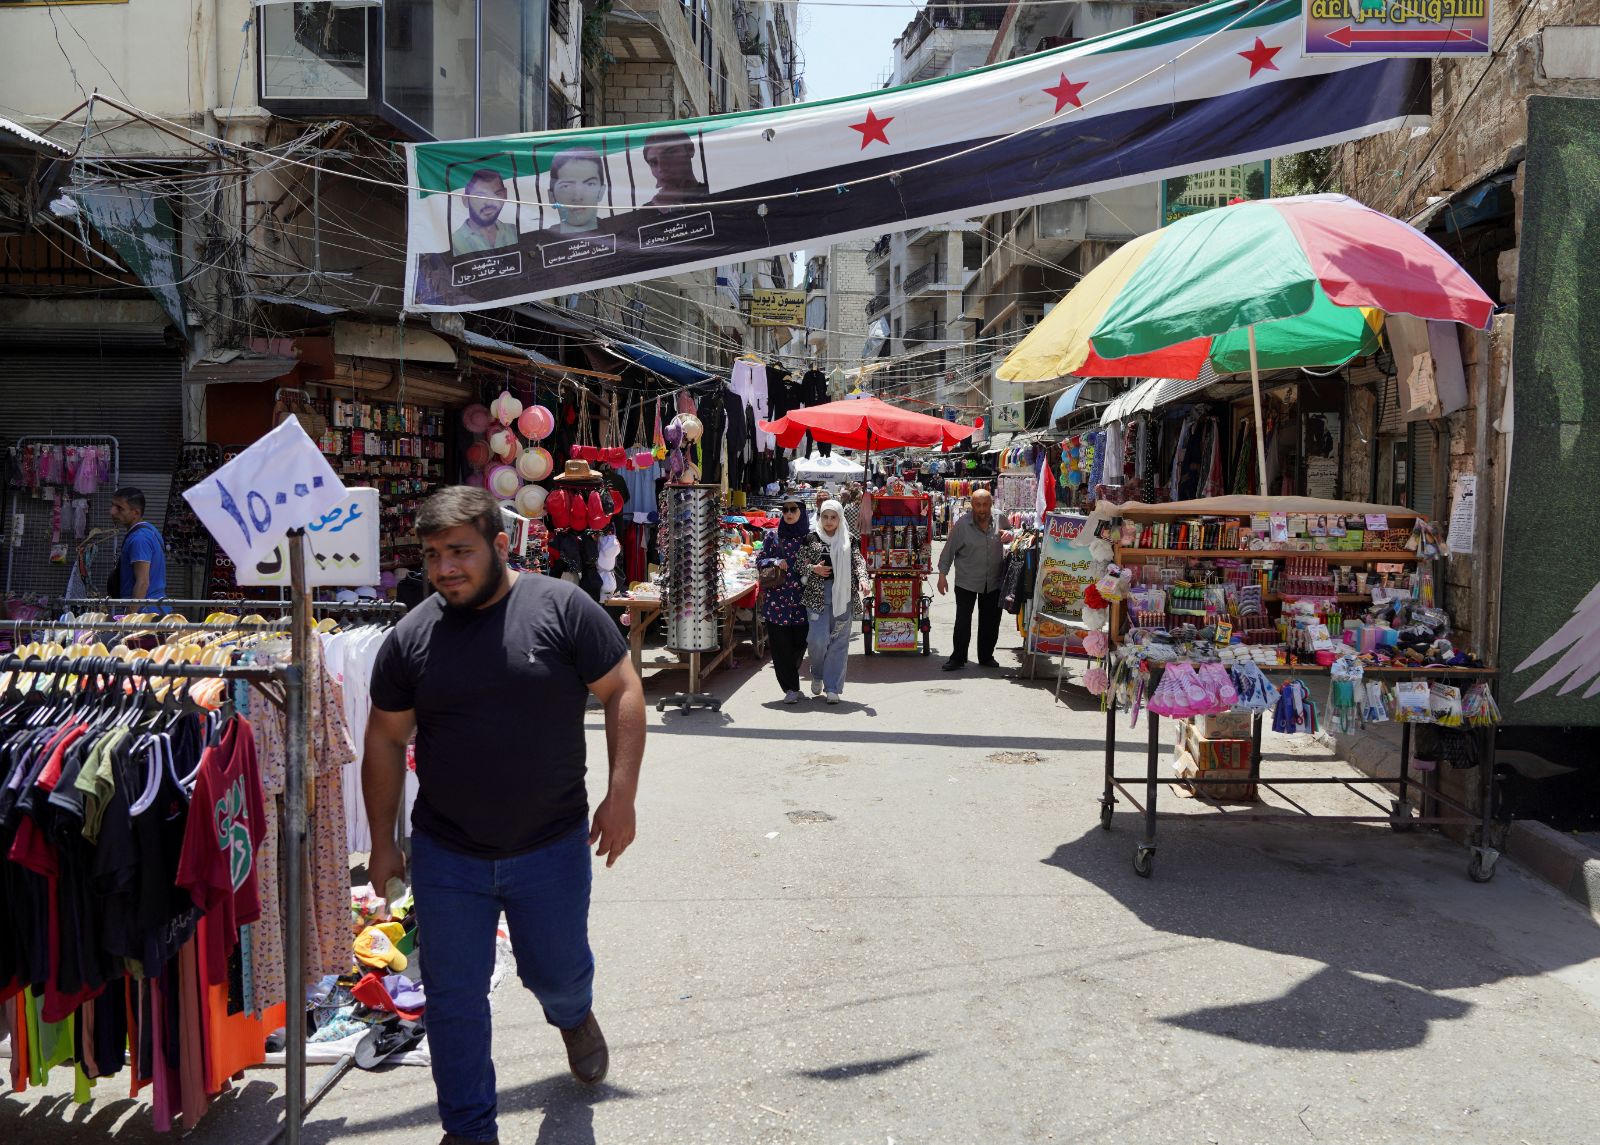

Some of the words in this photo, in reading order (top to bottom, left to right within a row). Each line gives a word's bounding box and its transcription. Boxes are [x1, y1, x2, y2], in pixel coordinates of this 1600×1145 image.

[663, 223, 688, 234] الشهيد
[669, 230, 689, 241] محمد
[568, 241, 591, 251] الشهيد
[471, 259, 500, 270] الشهيد
[477, 267, 497, 278] خالد
